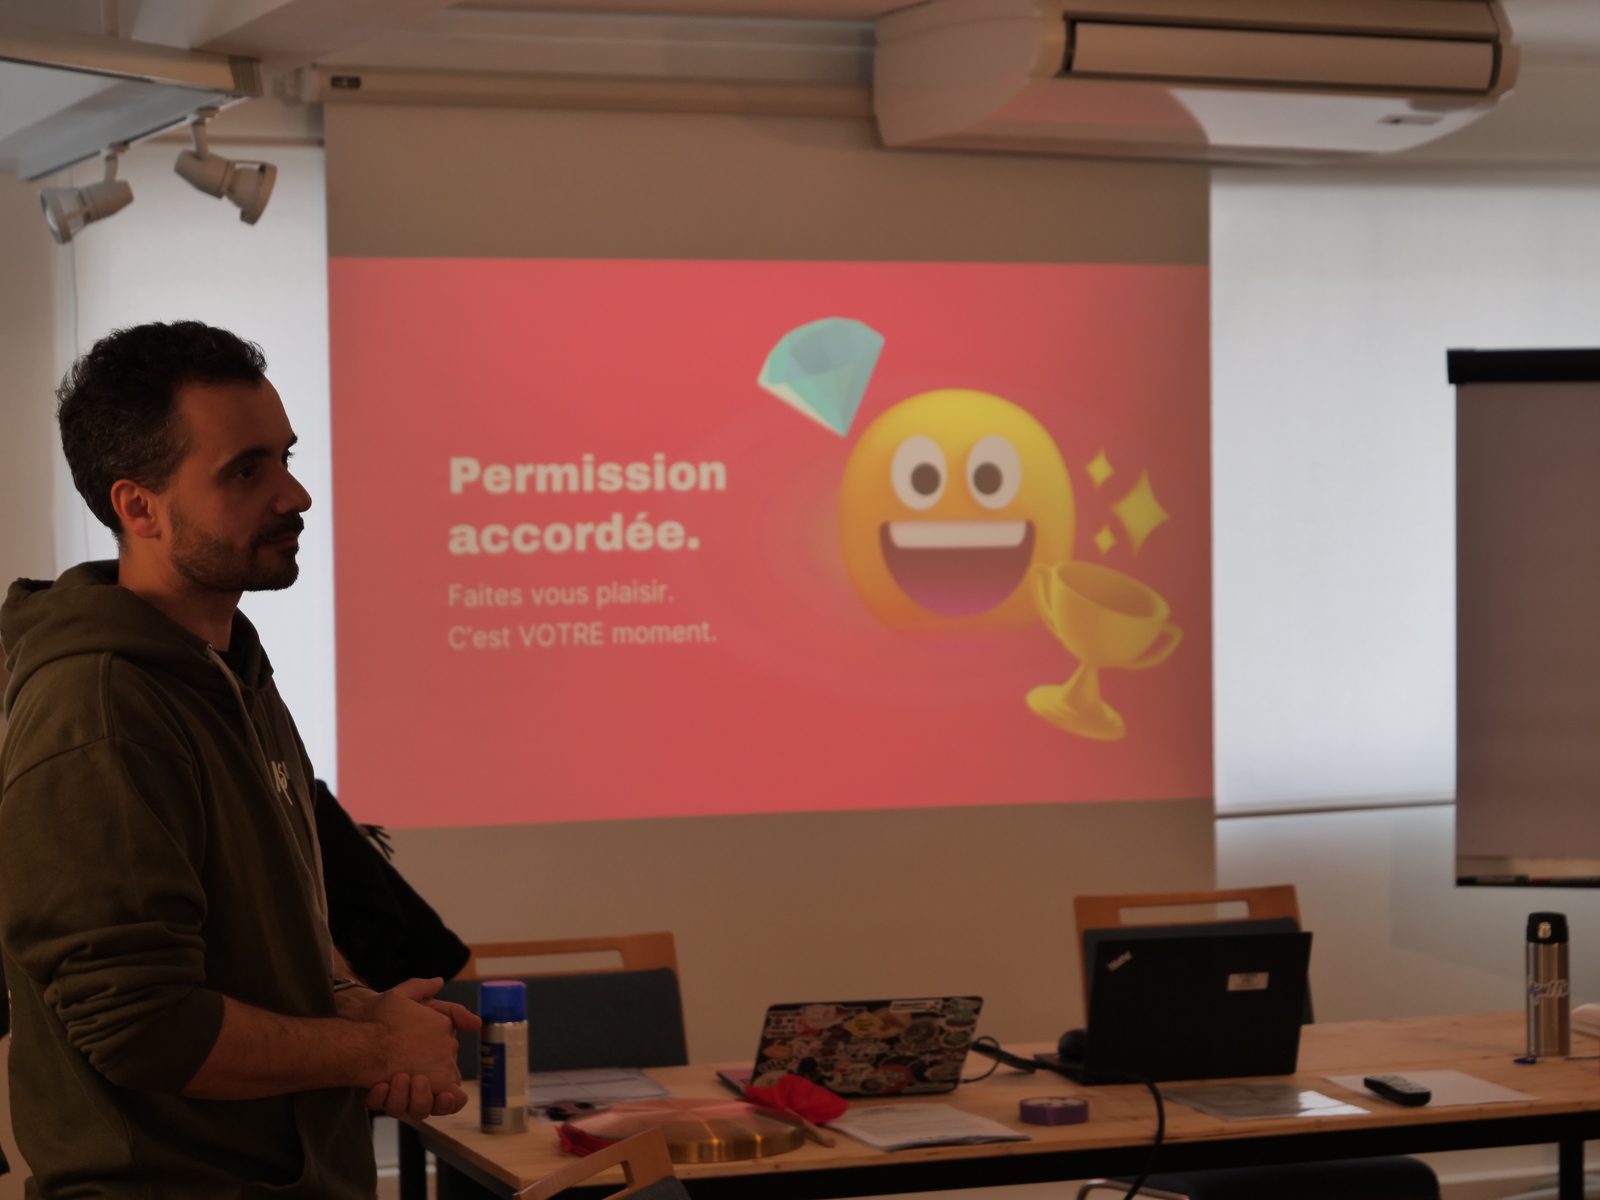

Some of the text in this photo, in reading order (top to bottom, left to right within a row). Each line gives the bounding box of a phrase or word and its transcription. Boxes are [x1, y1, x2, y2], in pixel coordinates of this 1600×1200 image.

[449, 452, 727, 494] Permission
[448, 511, 700, 555] accordée.
[448, 579, 676, 609] Faites vous plaisir.
[448, 621, 718, 650] C'est VOTRE moment.
